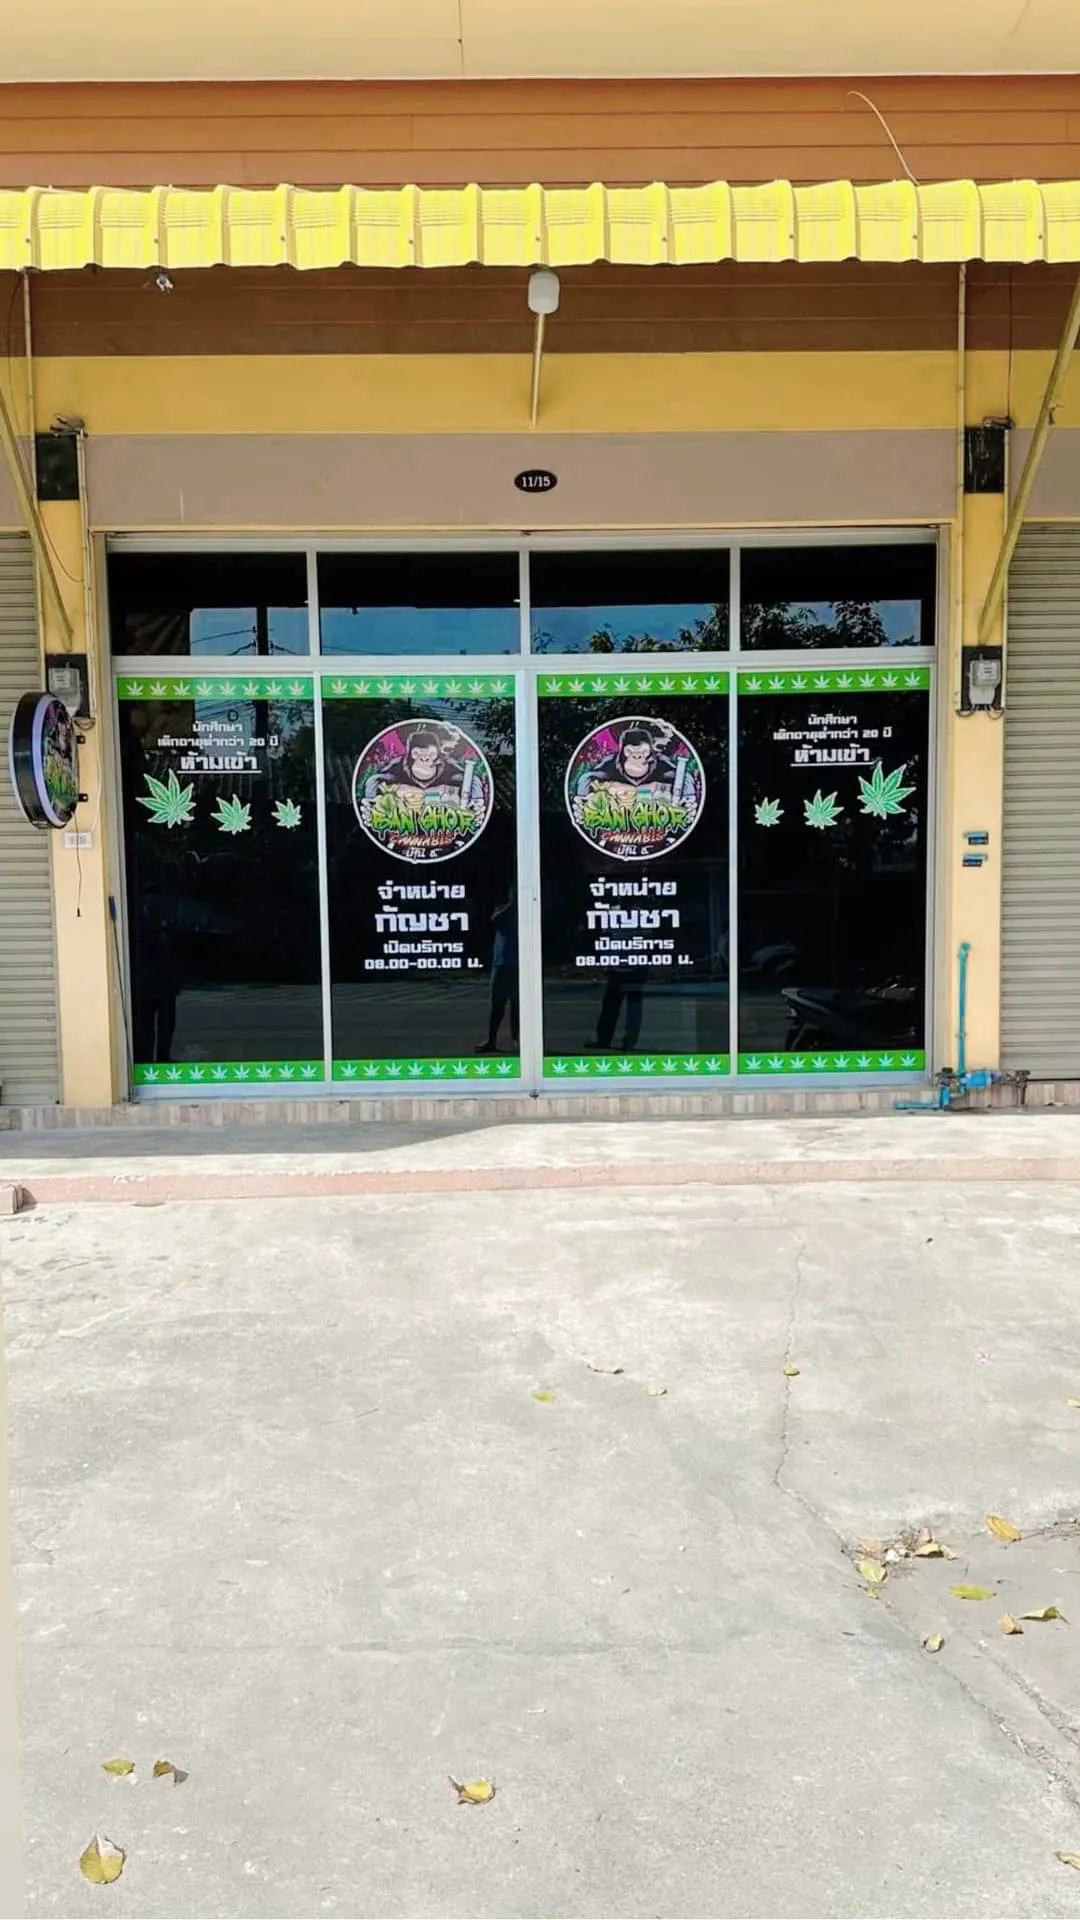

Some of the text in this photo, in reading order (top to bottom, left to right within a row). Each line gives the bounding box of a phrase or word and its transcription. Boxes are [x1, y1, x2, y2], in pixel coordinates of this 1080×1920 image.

[521, 475, 551, 488] 11/15
[808, 713, 858, 726] นักศึกษา
[862, 729, 879, 739] 20
[883, 726, 893, 738] ปี
[249, 738, 265, 747] 20
[269, 735, 278, 747] ปี
[794, 743, 870, 763] ห้ามเข้า
[180, 751, 258, 770] ห้ามเข้า
[391, 834, 453, 848] CANNABIS
[600, 830, 664, 844] CANNABIS
[377, 879, 466, 900] จำหน่าย
[589, 876, 677, 897] จำหน่าย
[374, 904, 469, 933] กัญชา
[586, 901, 680, 930] กัญชา
[383, 939, 464, 954] เปิดบริการ
[594, 936, 675, 951] เปิดบริการ
[364, 956, 485, 970] 08.00-00.00 น.
[575, 953, 695, 967] 08.00-00.00 น.
